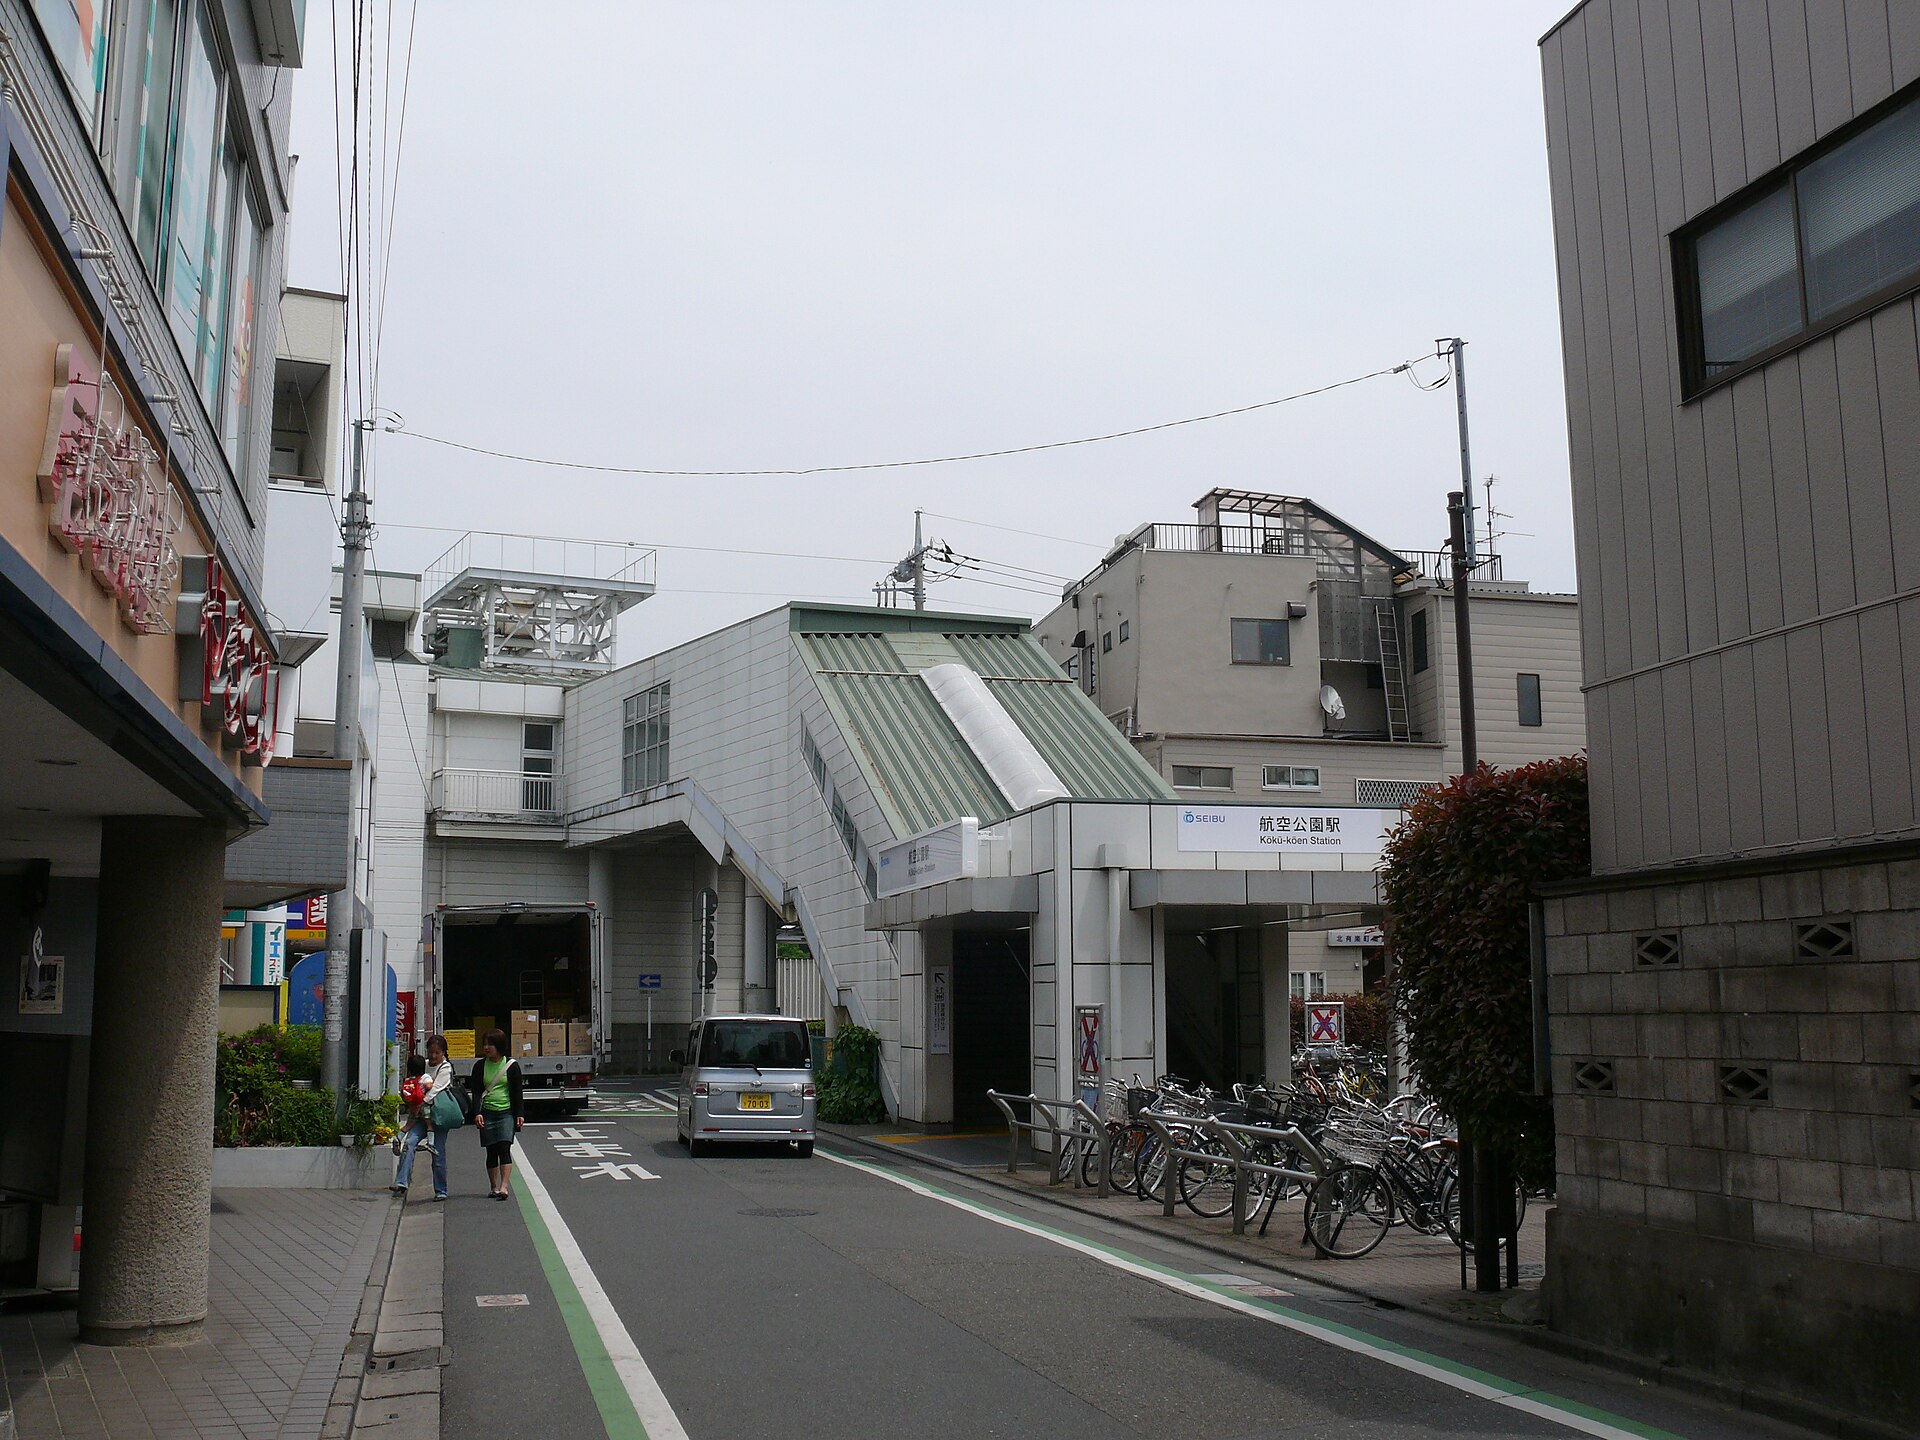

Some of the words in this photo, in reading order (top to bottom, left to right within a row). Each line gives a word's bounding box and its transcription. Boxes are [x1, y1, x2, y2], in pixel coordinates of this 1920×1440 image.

[1195, 814, 1226, 823] SEIBU
[1259, 815, 1341, 833] 航空公園駅
[1310, 836, 1341, 846] Station
[269, 926, 281, 985] イエステー
[547, 1128, 662, 1181] 止まれ
